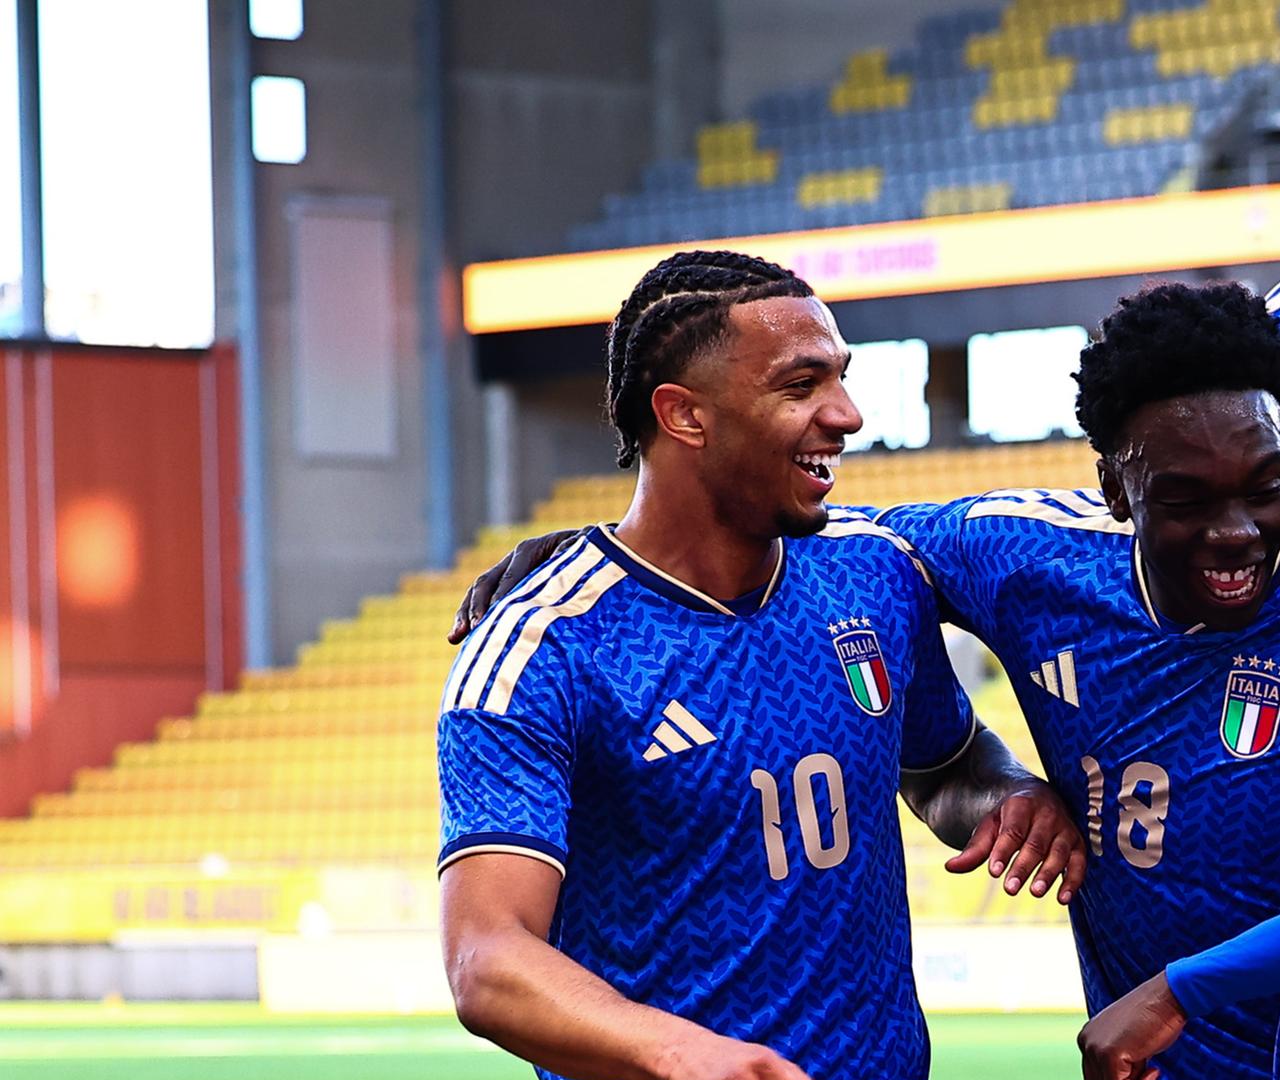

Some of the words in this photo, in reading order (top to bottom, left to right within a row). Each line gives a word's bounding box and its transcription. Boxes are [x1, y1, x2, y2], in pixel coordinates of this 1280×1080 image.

[839, 638, 877, 659] ITALIA
[1231, 677, 1279, 701] ITALIA
[750, 752, 851, 880] 10
[1080, 755, 1170, 869] 18
